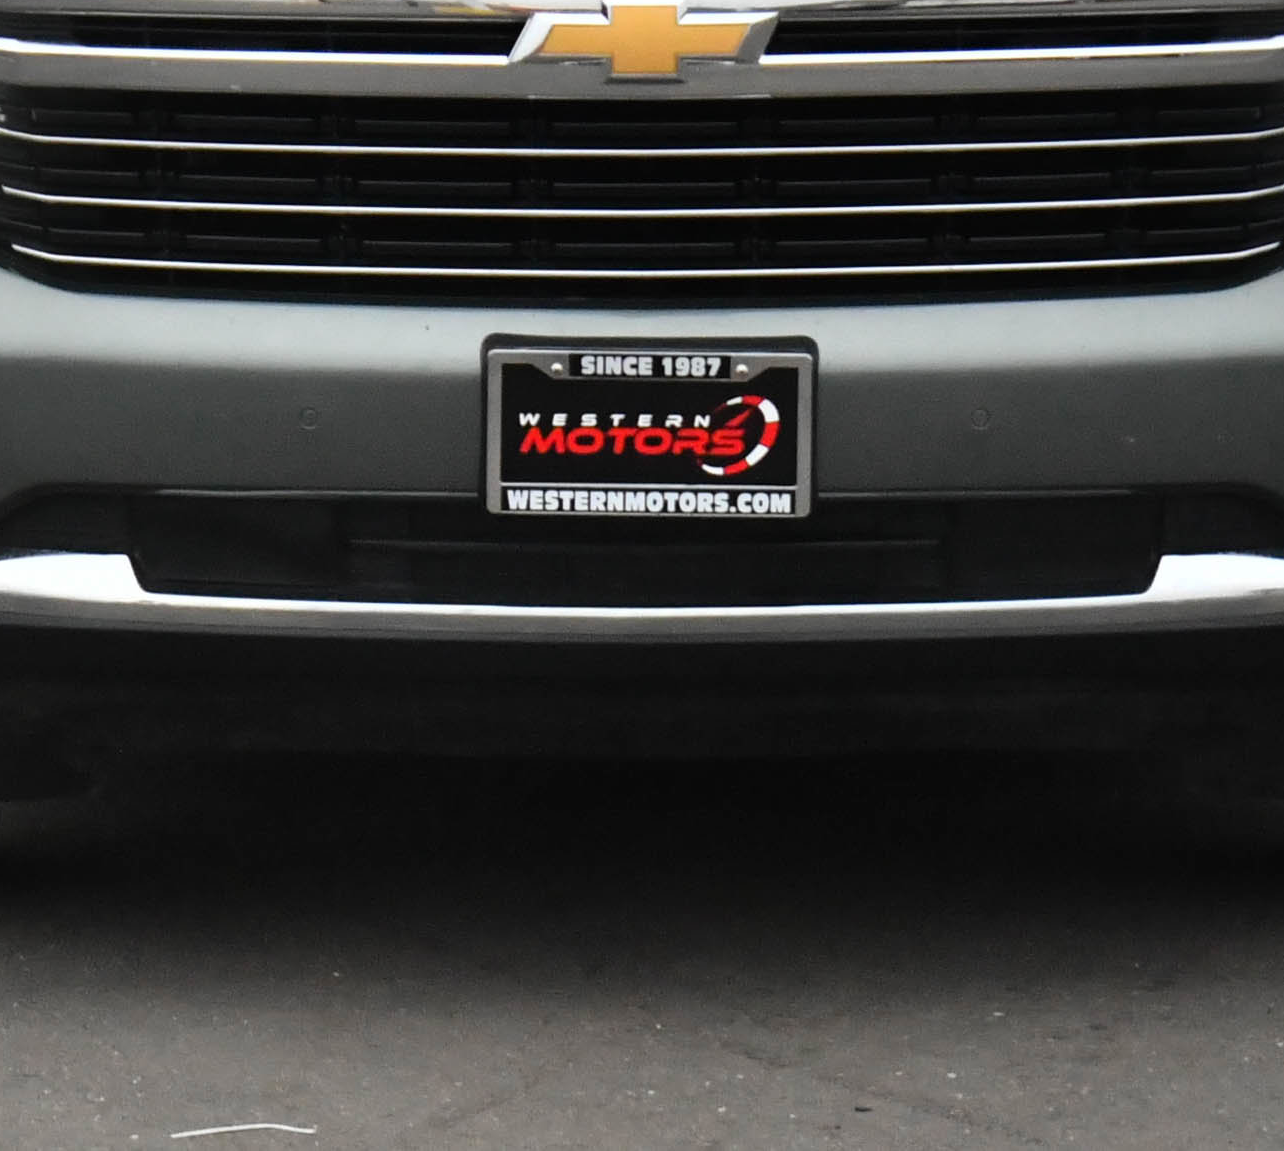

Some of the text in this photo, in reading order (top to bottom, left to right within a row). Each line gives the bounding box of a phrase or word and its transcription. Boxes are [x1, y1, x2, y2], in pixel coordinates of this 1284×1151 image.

[580, 355, 723, 378] SINCE 1987
[518, 412, 712, 428] WESTERN
[519, 427, 746, 455] MOTORS
[507, 488, 792, 514] WESTERNMOTORS.COM
